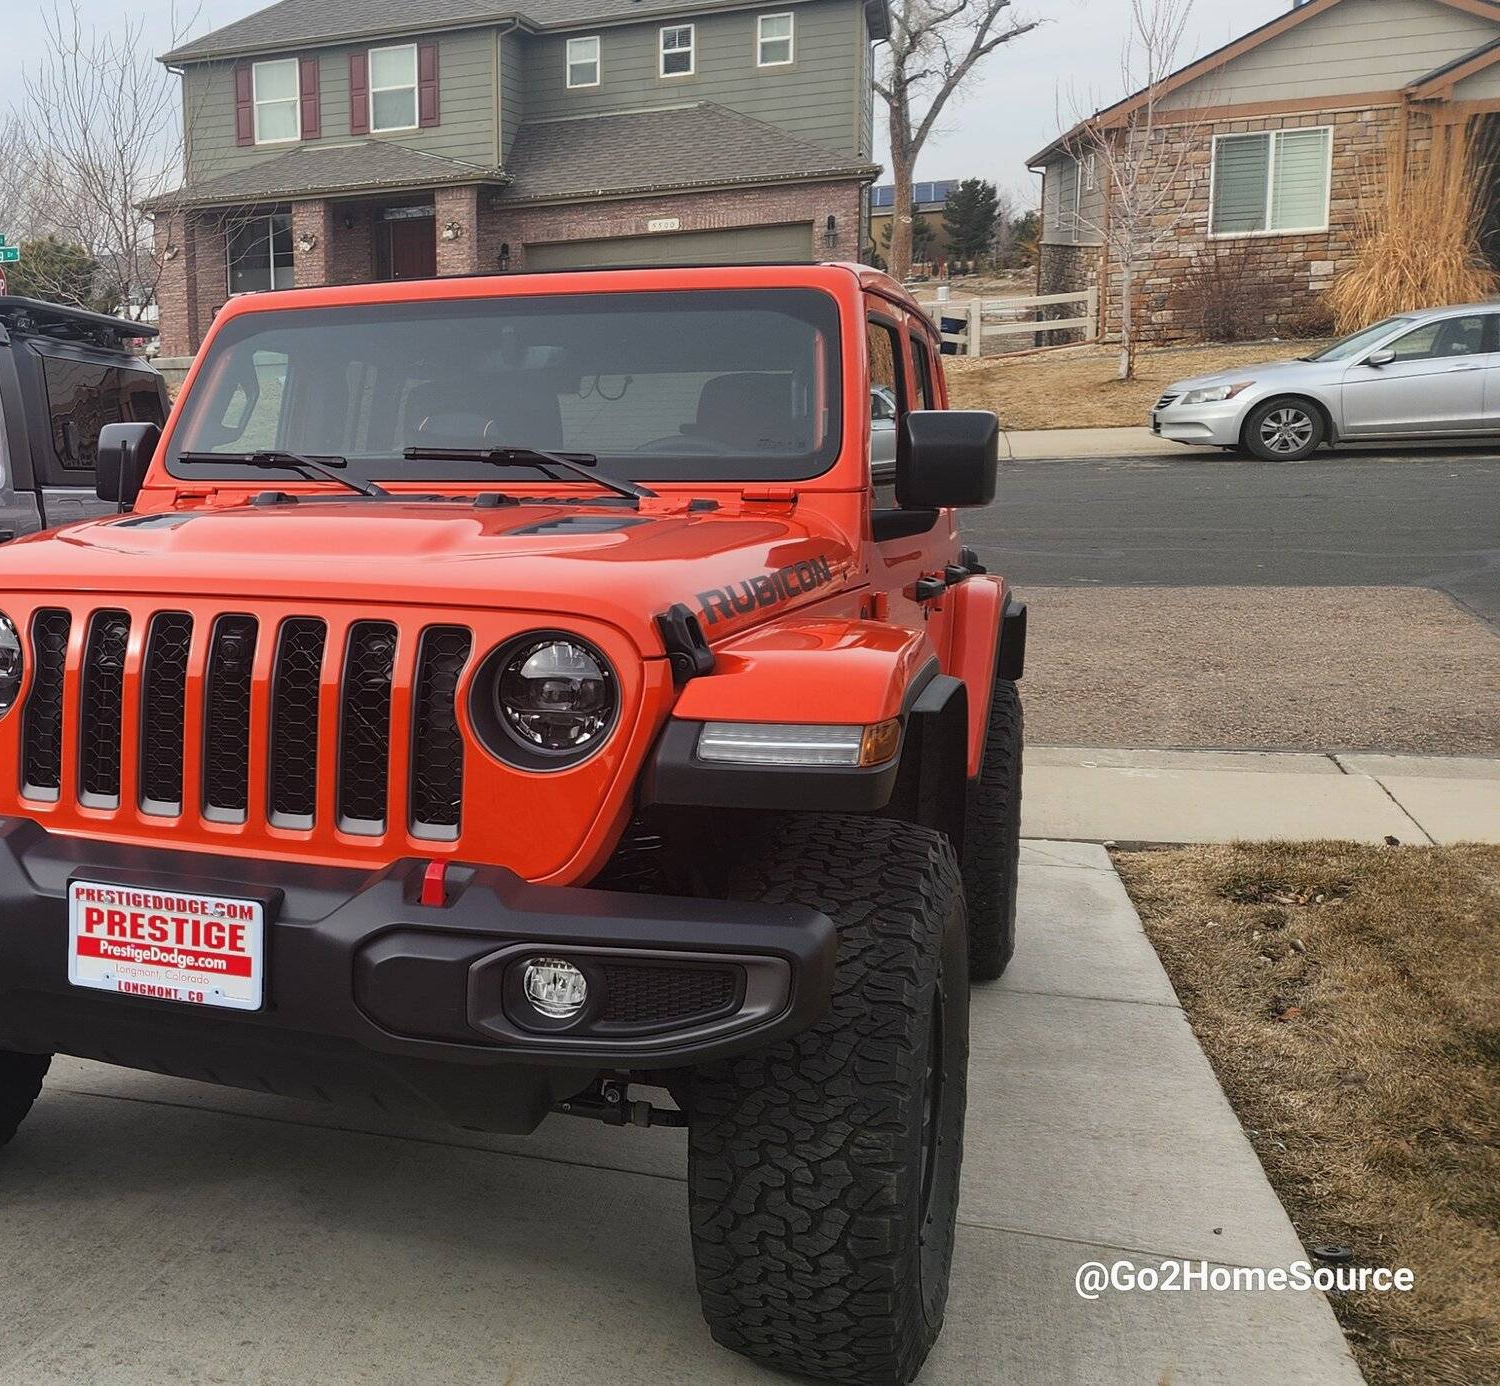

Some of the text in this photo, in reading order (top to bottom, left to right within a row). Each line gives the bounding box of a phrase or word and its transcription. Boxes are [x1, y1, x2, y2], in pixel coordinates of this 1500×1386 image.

[695, 554, 833, 625] RUBICON
[75, 887, 254, 921] PRESTIGEDODGE.COM
[84, 906, 246, 953] PRESTIGE
[99, 939, 228, 970] PrestigeDodge.com
[164, 969, 211, 985] Colorado
[187, 990, 204, 1003] CO
